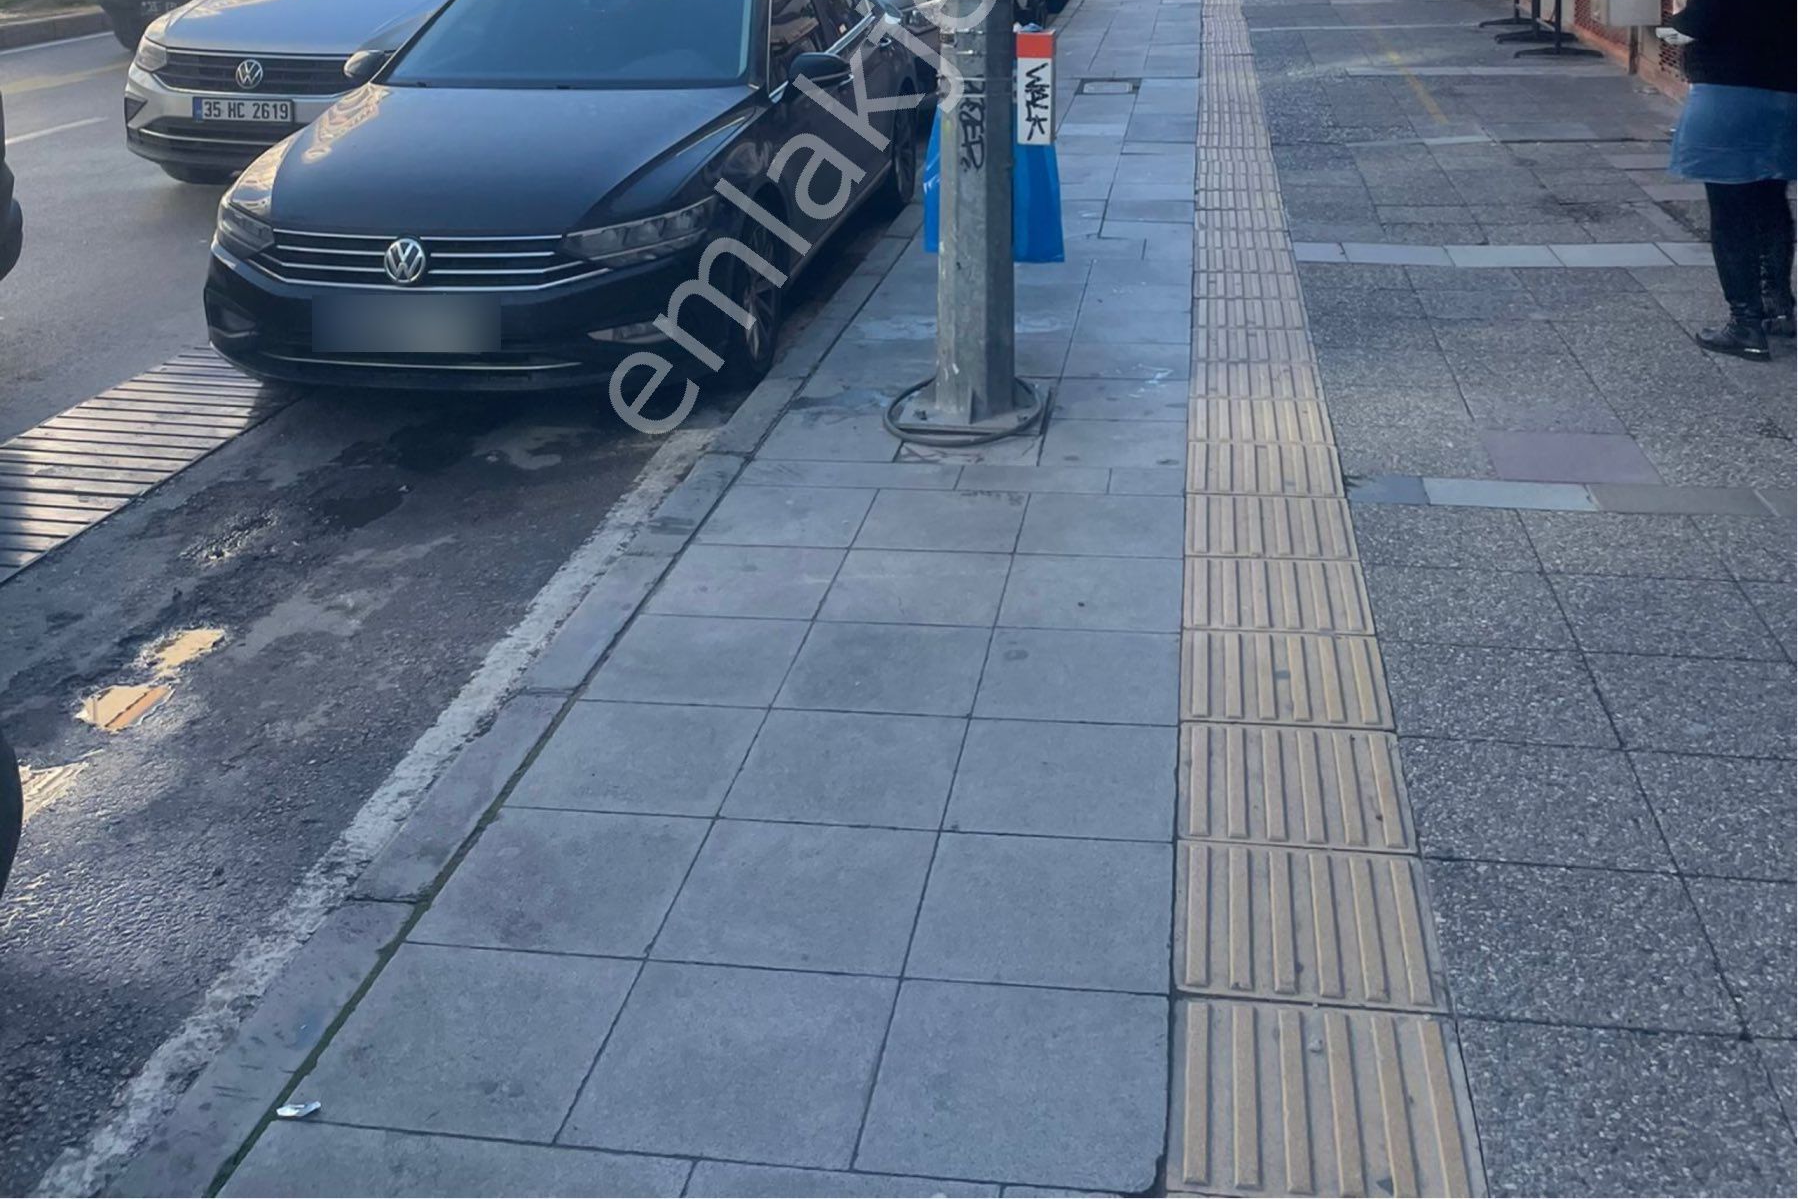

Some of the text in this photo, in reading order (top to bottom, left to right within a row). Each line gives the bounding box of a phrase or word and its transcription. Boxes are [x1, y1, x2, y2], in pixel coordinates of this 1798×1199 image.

[204, 102, 289, 120] 35 HC 2619
